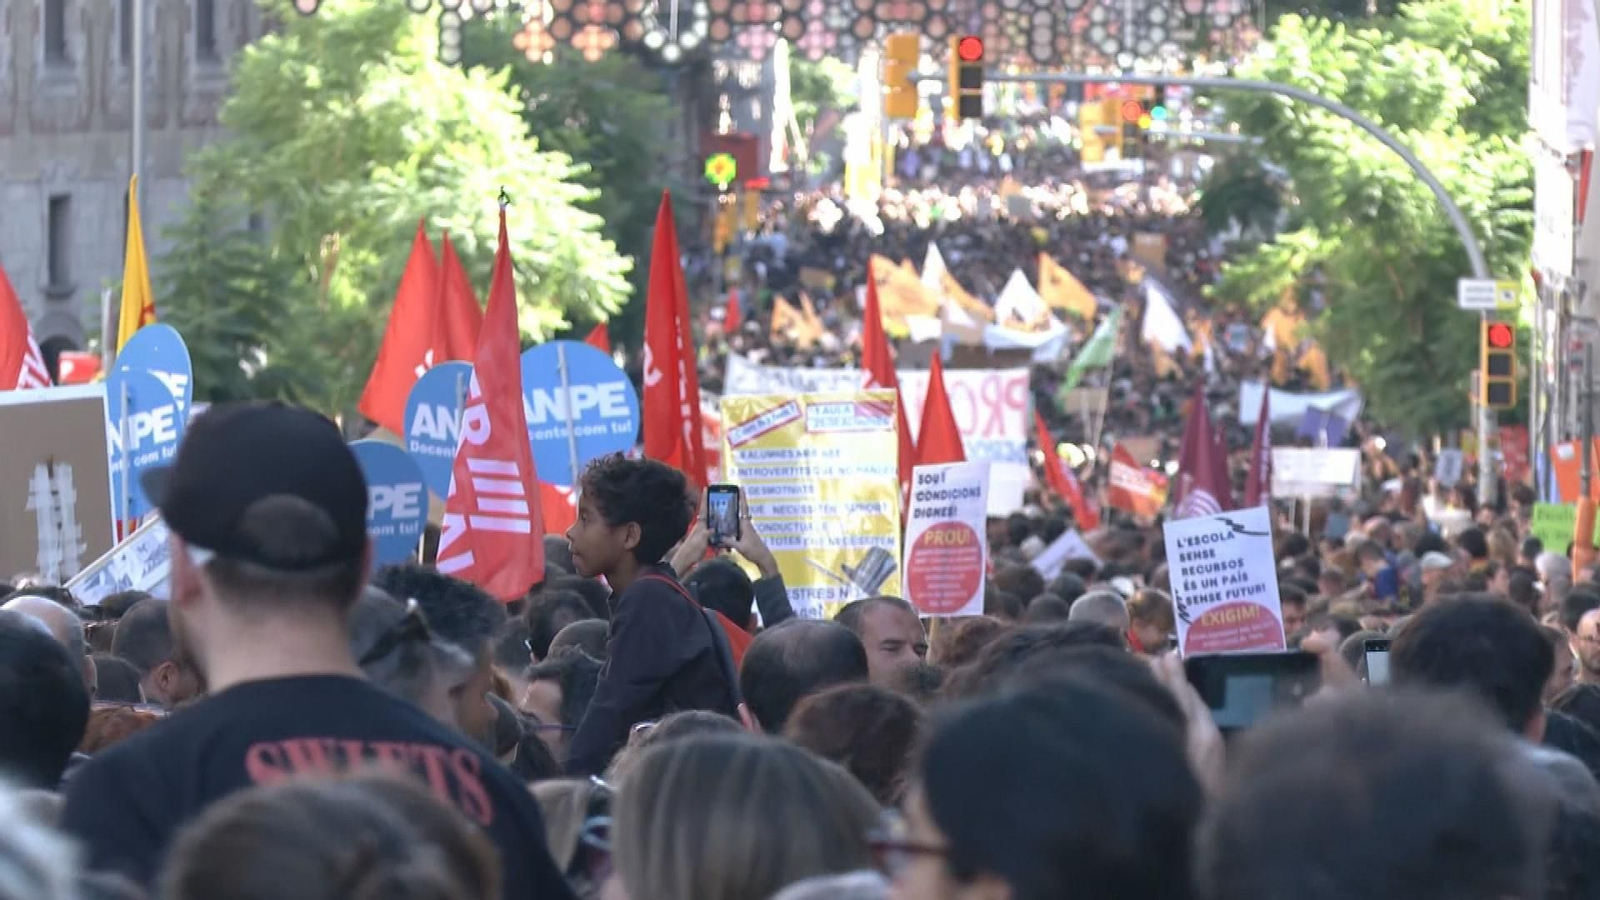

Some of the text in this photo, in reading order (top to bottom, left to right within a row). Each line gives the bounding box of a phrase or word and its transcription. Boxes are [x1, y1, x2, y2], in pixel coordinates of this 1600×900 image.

[107, 404, 177, 454] NPE
[410, 403, 460, 442] AN
[410, 440, 456, 459] Docent
[737, 466, 811, 478] INTROVERTITS
[918, 472, 940, 486] SOU
[749, 484, 815, 495] DESMOTIVATS
[915, 485, 982, 502] CONDICIONS
[367, 481, 423, 520] PE
[913, 505, 958, 519] DIGNES!
[924, 529, 971, 546] PROU!
[1176, 531, 1236, 548] L'ESCOLA
[1179, 548, 1216, 563] SENSE
[1181, 558, 1245, 577] RECURSOS
[1183, 572, 1249, 593] ÉS UN PAÍS
[1185, 583, 1267, 607] SENSE FUTUR!
[1202, 605, 1261, 627] EXIGIM!
